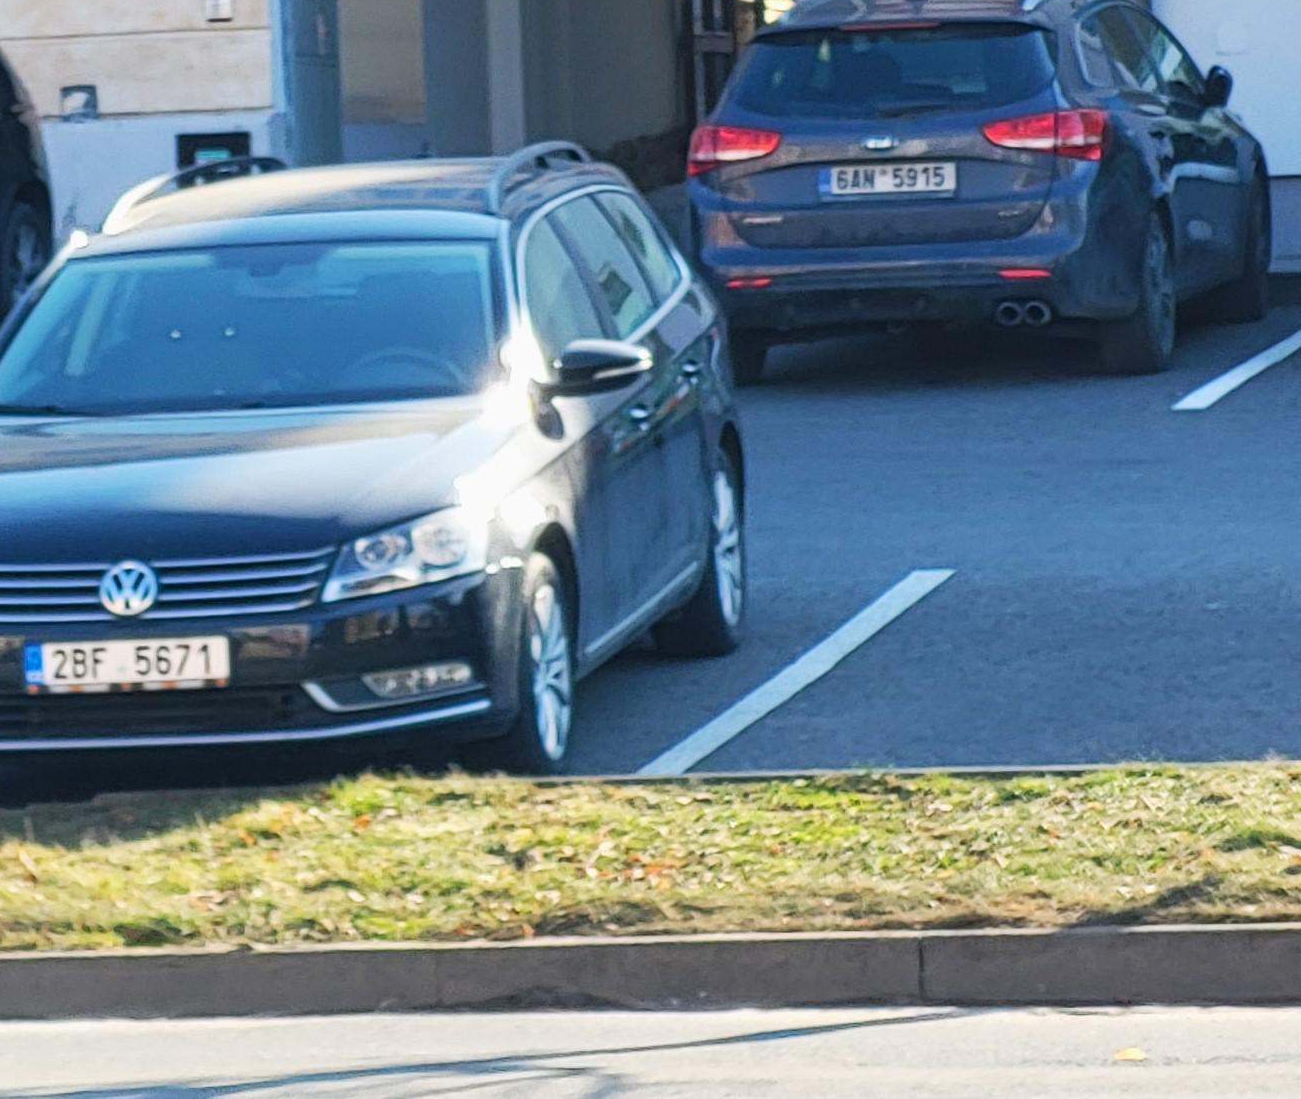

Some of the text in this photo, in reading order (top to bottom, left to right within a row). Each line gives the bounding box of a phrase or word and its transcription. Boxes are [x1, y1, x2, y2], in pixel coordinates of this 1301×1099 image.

[836, 166, 945, 190] 6AN 5915
[53, 643, 212, 679] 2BF 5671
